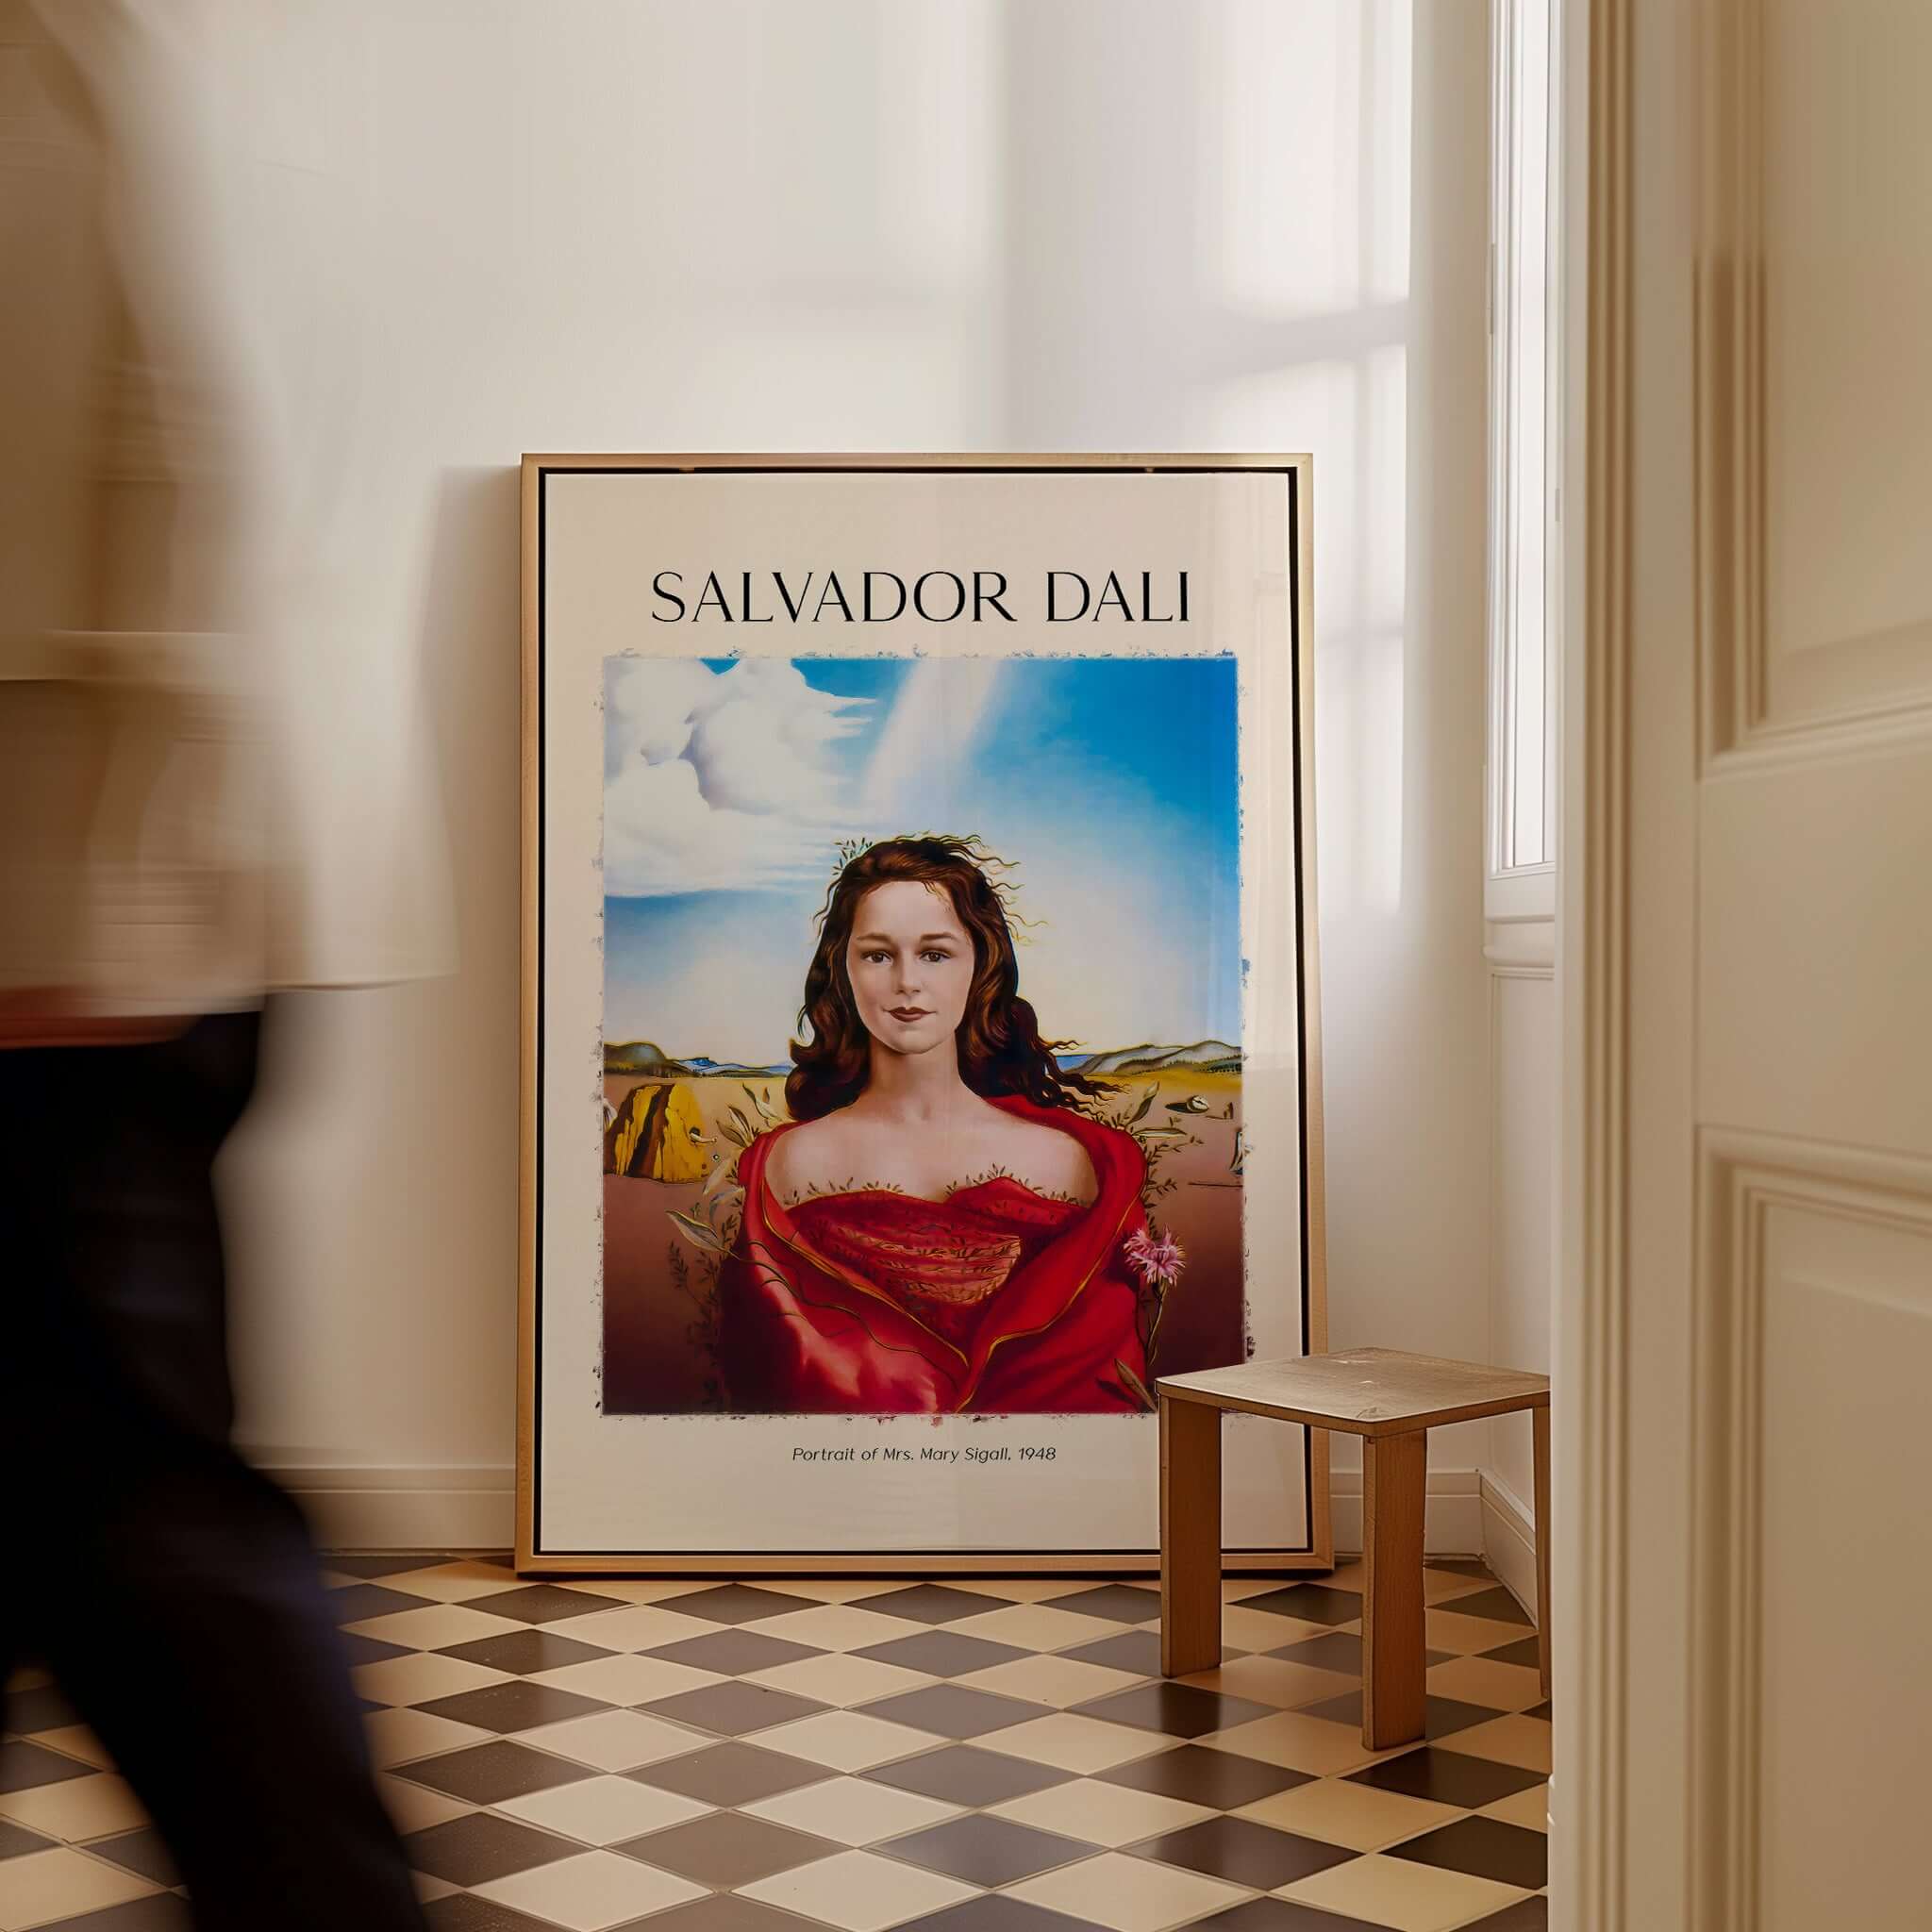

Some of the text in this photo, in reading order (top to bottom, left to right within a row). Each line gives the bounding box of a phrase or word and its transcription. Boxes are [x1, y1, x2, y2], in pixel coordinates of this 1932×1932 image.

[652, 571, 1190, 624] SALVADOR DALI
[791, 1447, 856, 1461] Portrait
[860, 1447, 879, 1461] of
[882, 1447, 914, 1461] Mrs.
[920, 1447, 960, 1464] Mary
[1018, 1446, 1057, 1461] 1948
